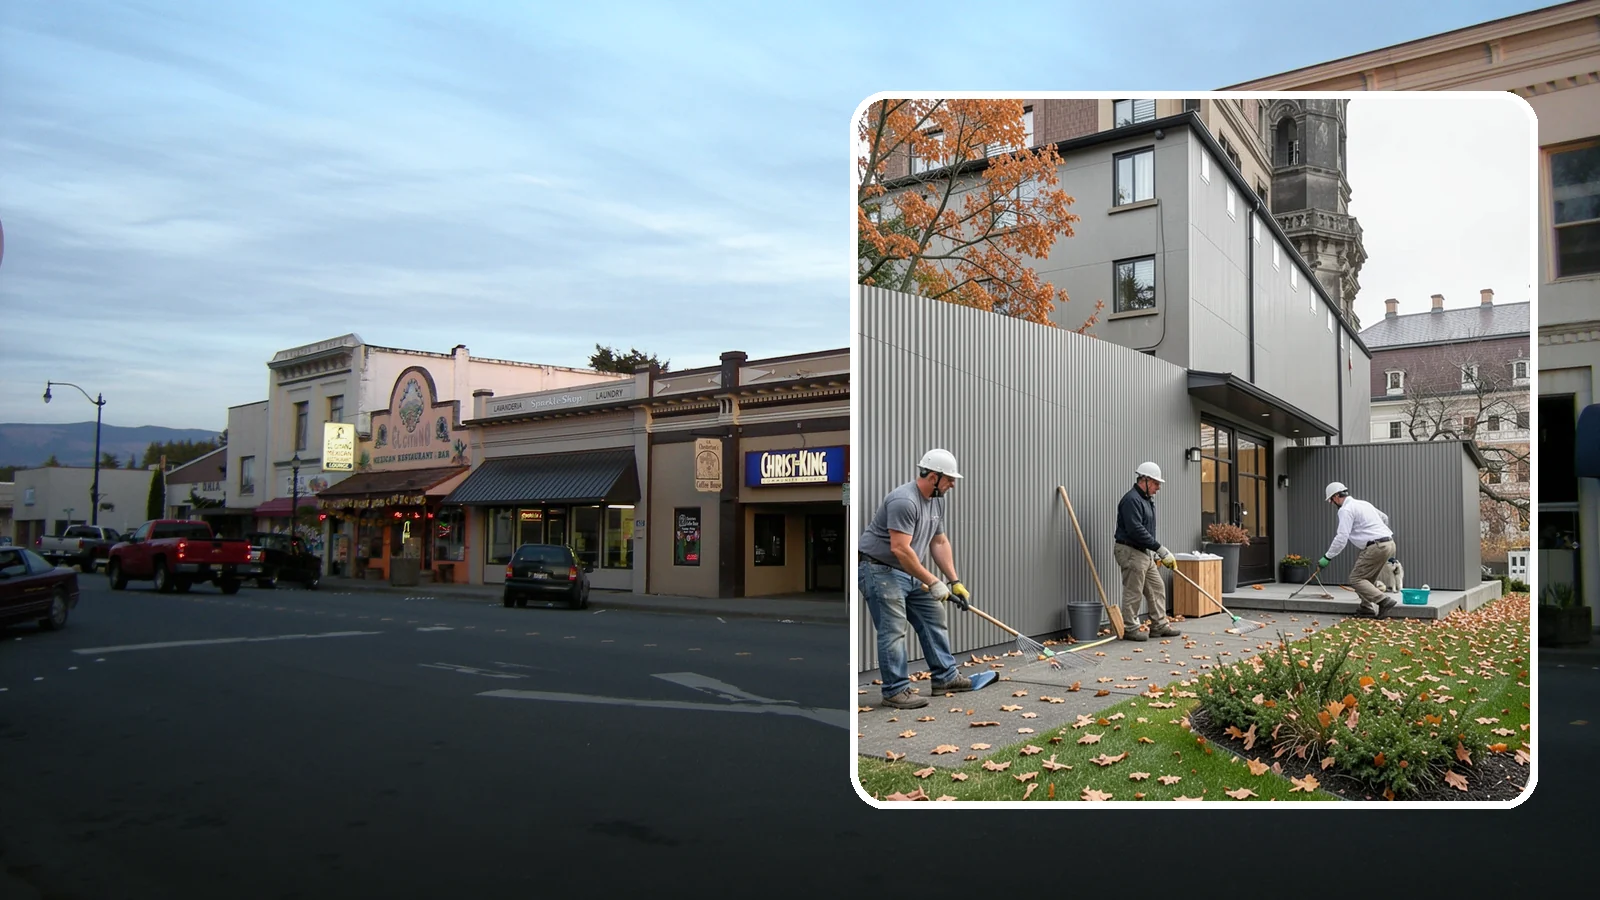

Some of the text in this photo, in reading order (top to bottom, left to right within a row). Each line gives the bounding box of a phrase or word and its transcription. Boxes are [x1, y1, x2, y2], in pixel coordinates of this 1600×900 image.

[493, 402, 523, 412] LAVANDERIA
[561, 395, 582, 405] Shop
[595, 389, 624, 400] LAUNDRY
[373, 454, 396, 464] MEXICAN
[397, 451, 433, 462] RESTAURANT
[438, 450, 450, 459] BAR
[760, 450, 828, 477] CHRIST KING
